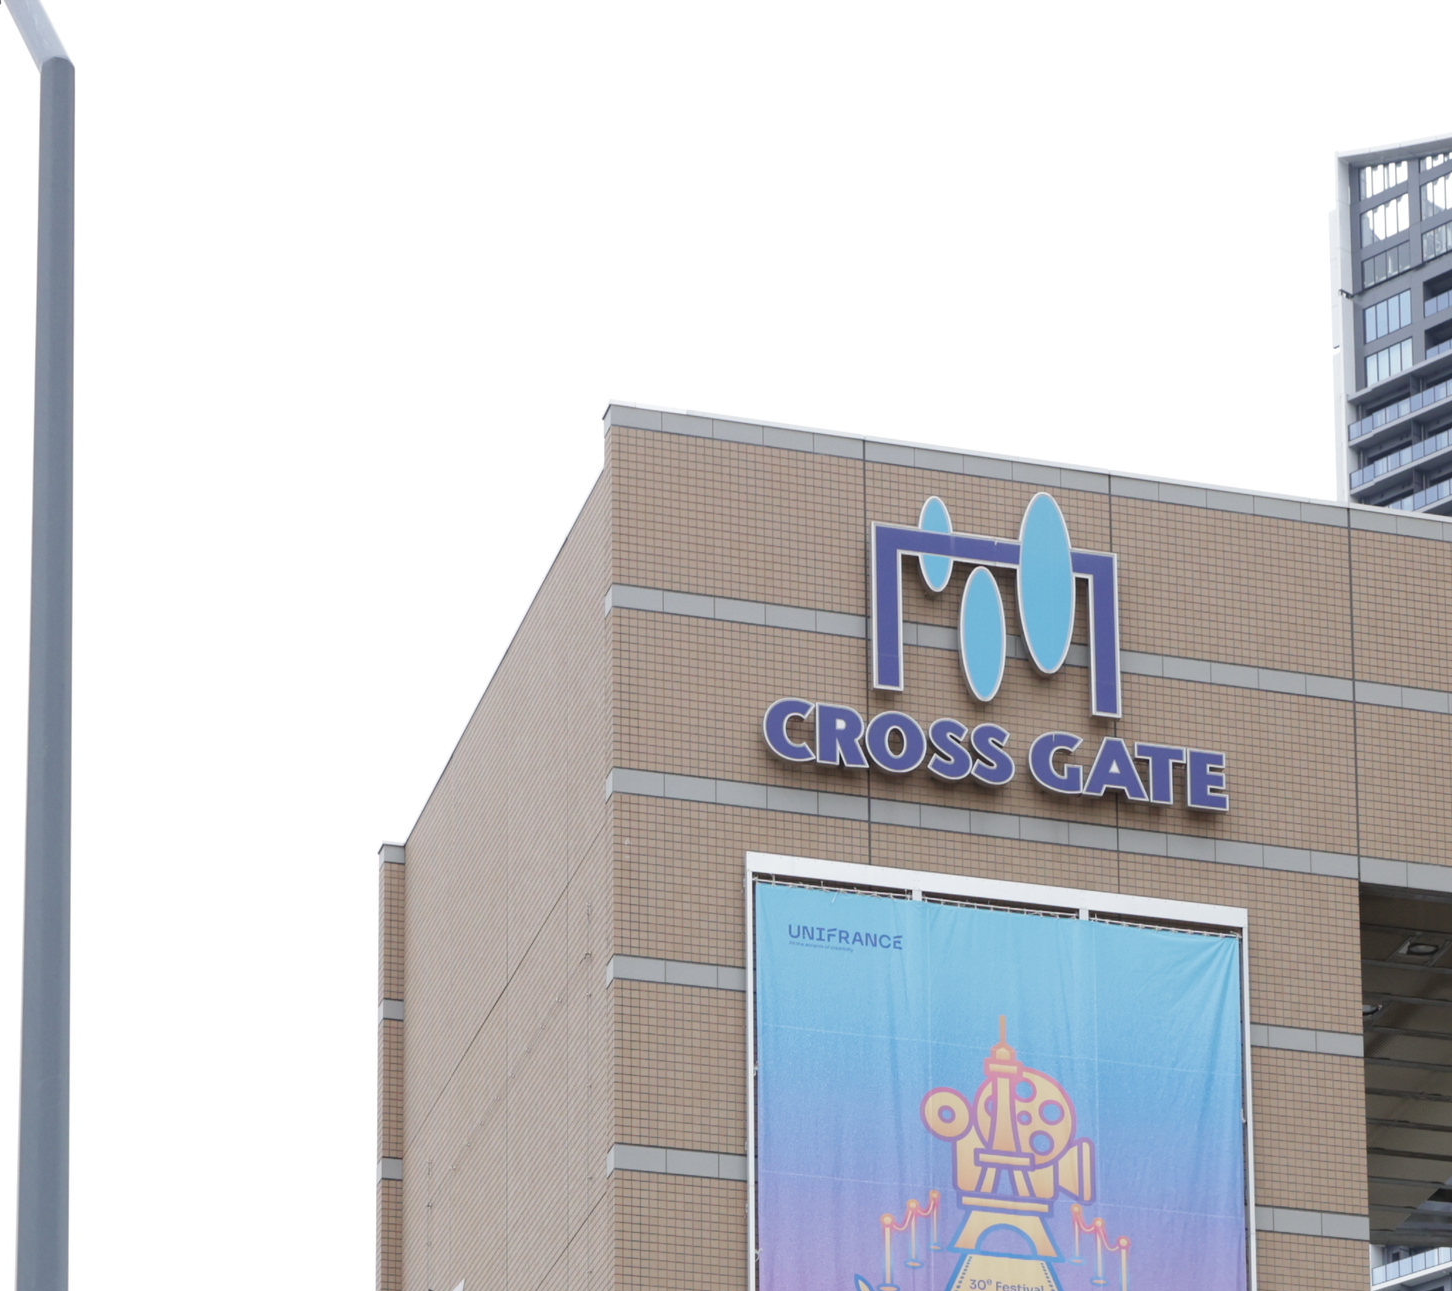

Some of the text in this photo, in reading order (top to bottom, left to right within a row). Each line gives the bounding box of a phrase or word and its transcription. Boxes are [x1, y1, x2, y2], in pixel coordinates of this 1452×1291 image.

[763, 697, 1229, 811] CROSS GATE
[788, 924, 903, 950] UNIFRANCE
